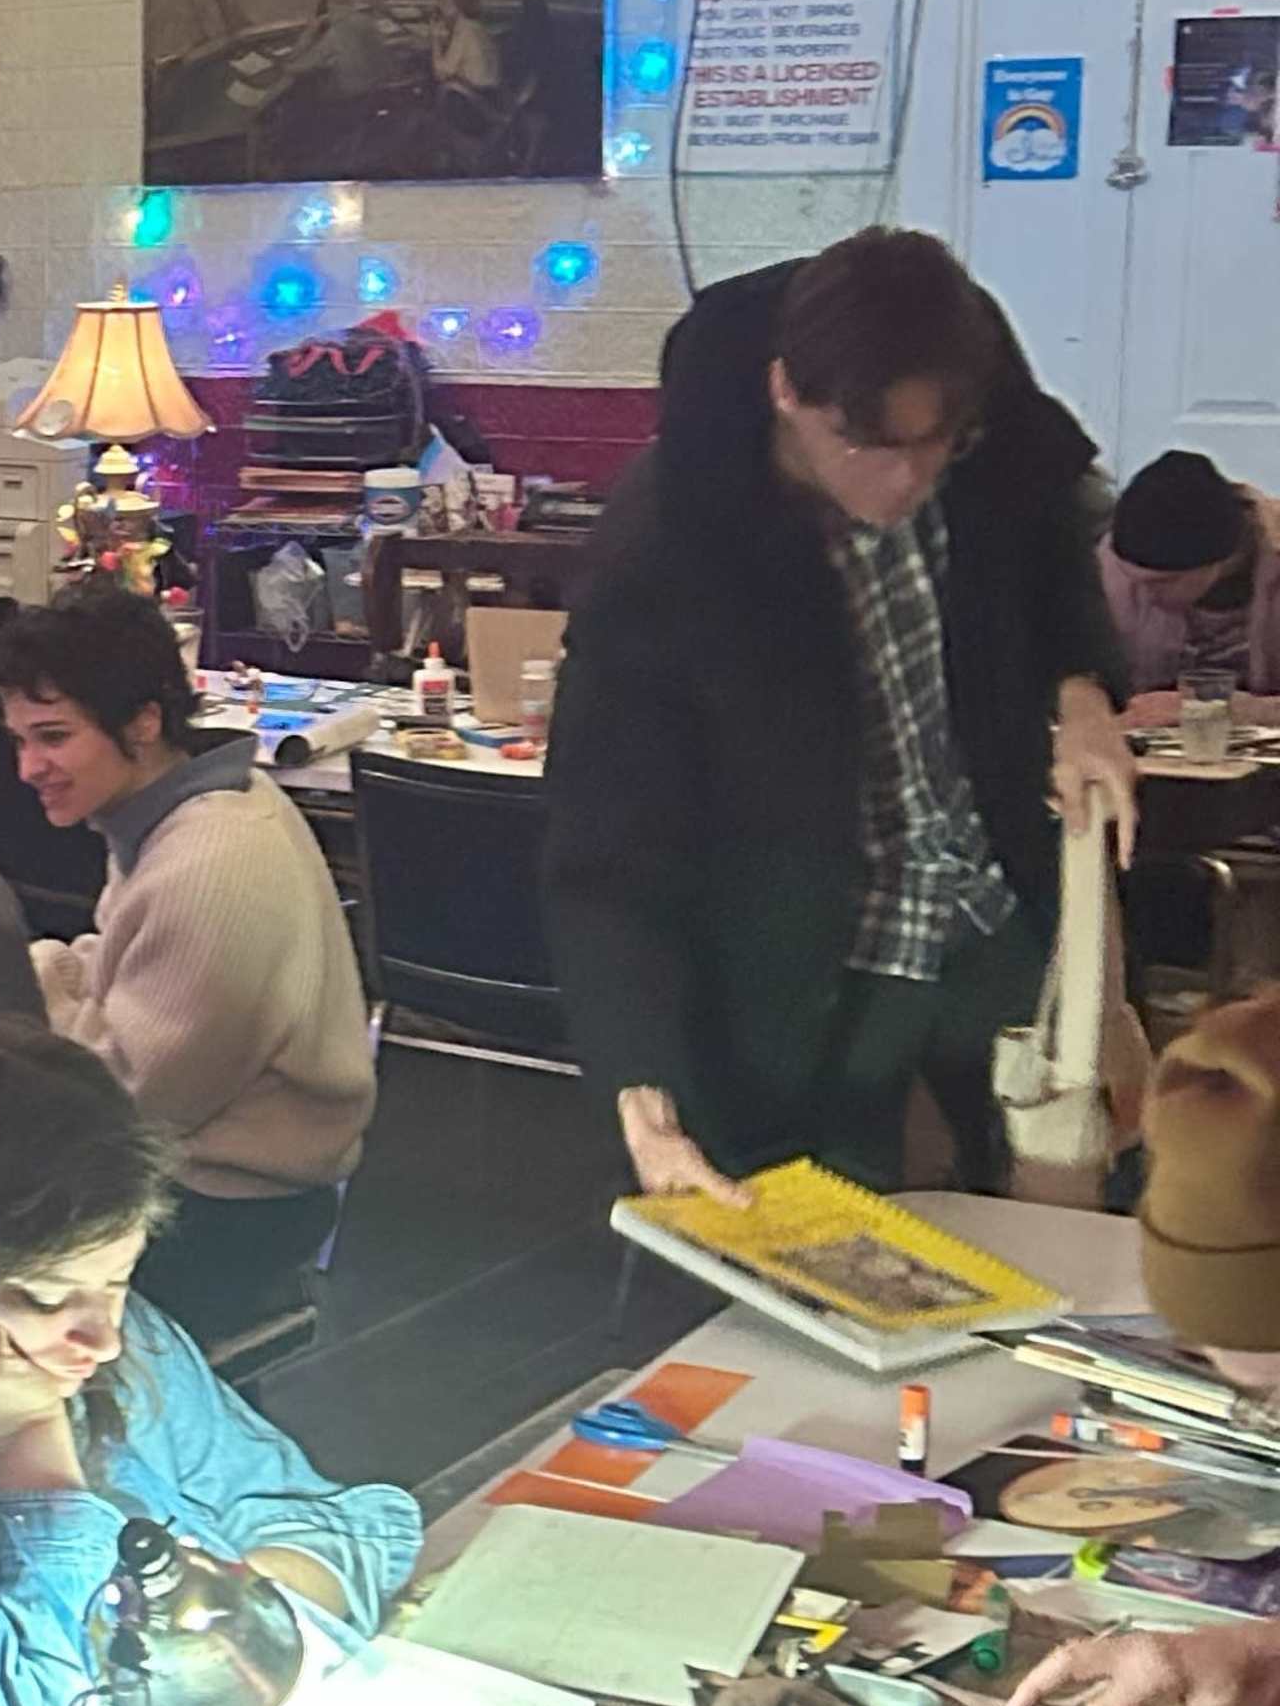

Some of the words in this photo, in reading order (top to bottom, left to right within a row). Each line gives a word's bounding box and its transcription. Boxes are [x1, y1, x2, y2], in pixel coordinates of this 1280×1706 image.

[769, 5, 800, 19] NOT
[806, 3, 854, 18] BRING
[772, 24, 861, 38] BEVERAGES
[737, 45, 768, 59] THIS
[774, 43, 851, 58] PROPERTY
[730, 65, 748, 83] IS
[753, 64, 767, 82] A
[773, 61, 880, 83] LICENSED
[694, 87, 874, 108] ESTABLISHMENT
[724, 114, 764, 127] MUST
[770, 113, 851, 126] PURCHASE
[688, 133, 769, 146] BEVERAGES
[772, 132, 811, 145] FROM
[817, 132, 844, 144] THE
